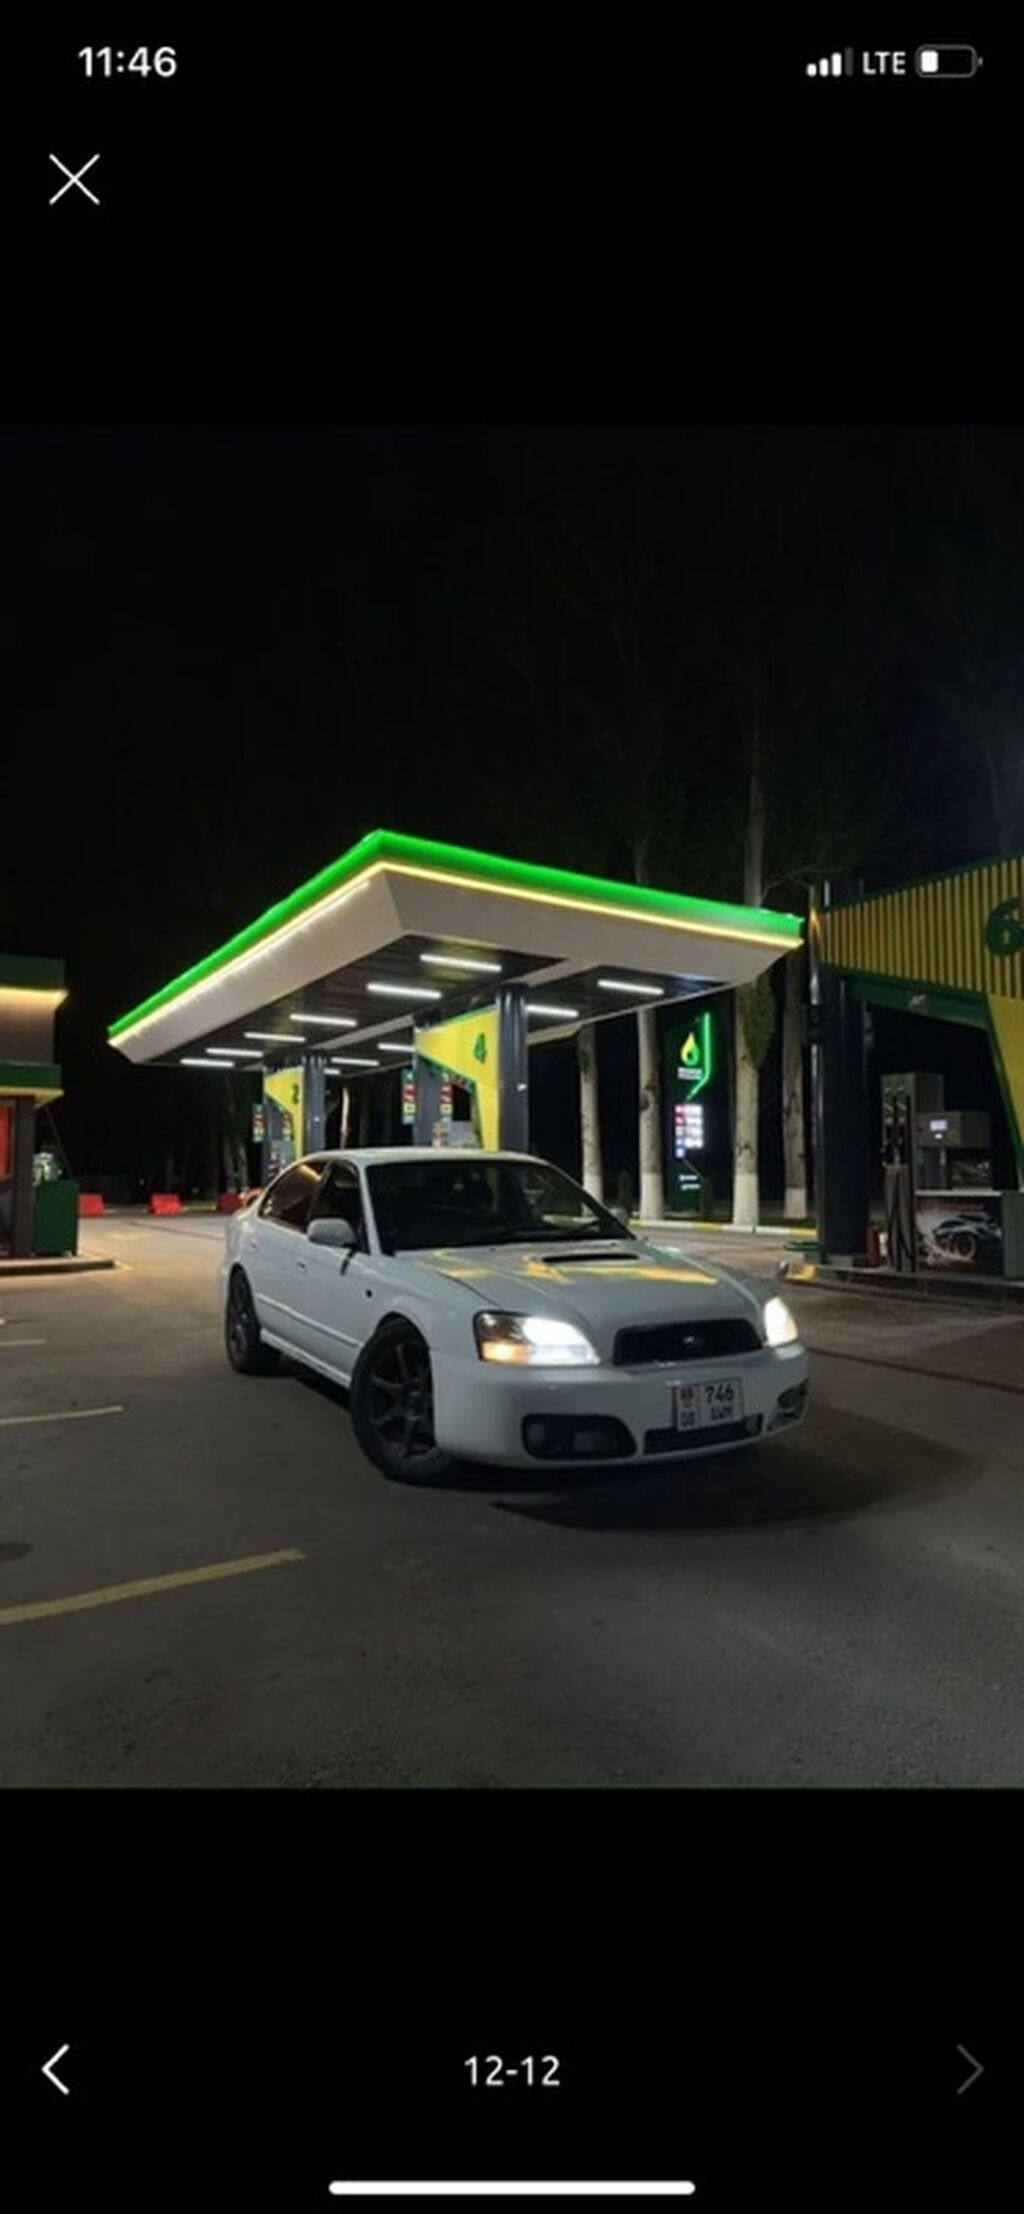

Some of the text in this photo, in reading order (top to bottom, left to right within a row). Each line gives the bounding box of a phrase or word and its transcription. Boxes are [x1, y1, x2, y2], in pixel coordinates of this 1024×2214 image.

[986, 897, 1024, 957] 6
[474, 1032, 487, 1064] 4
[704, 1384, 734, 1404] 746
